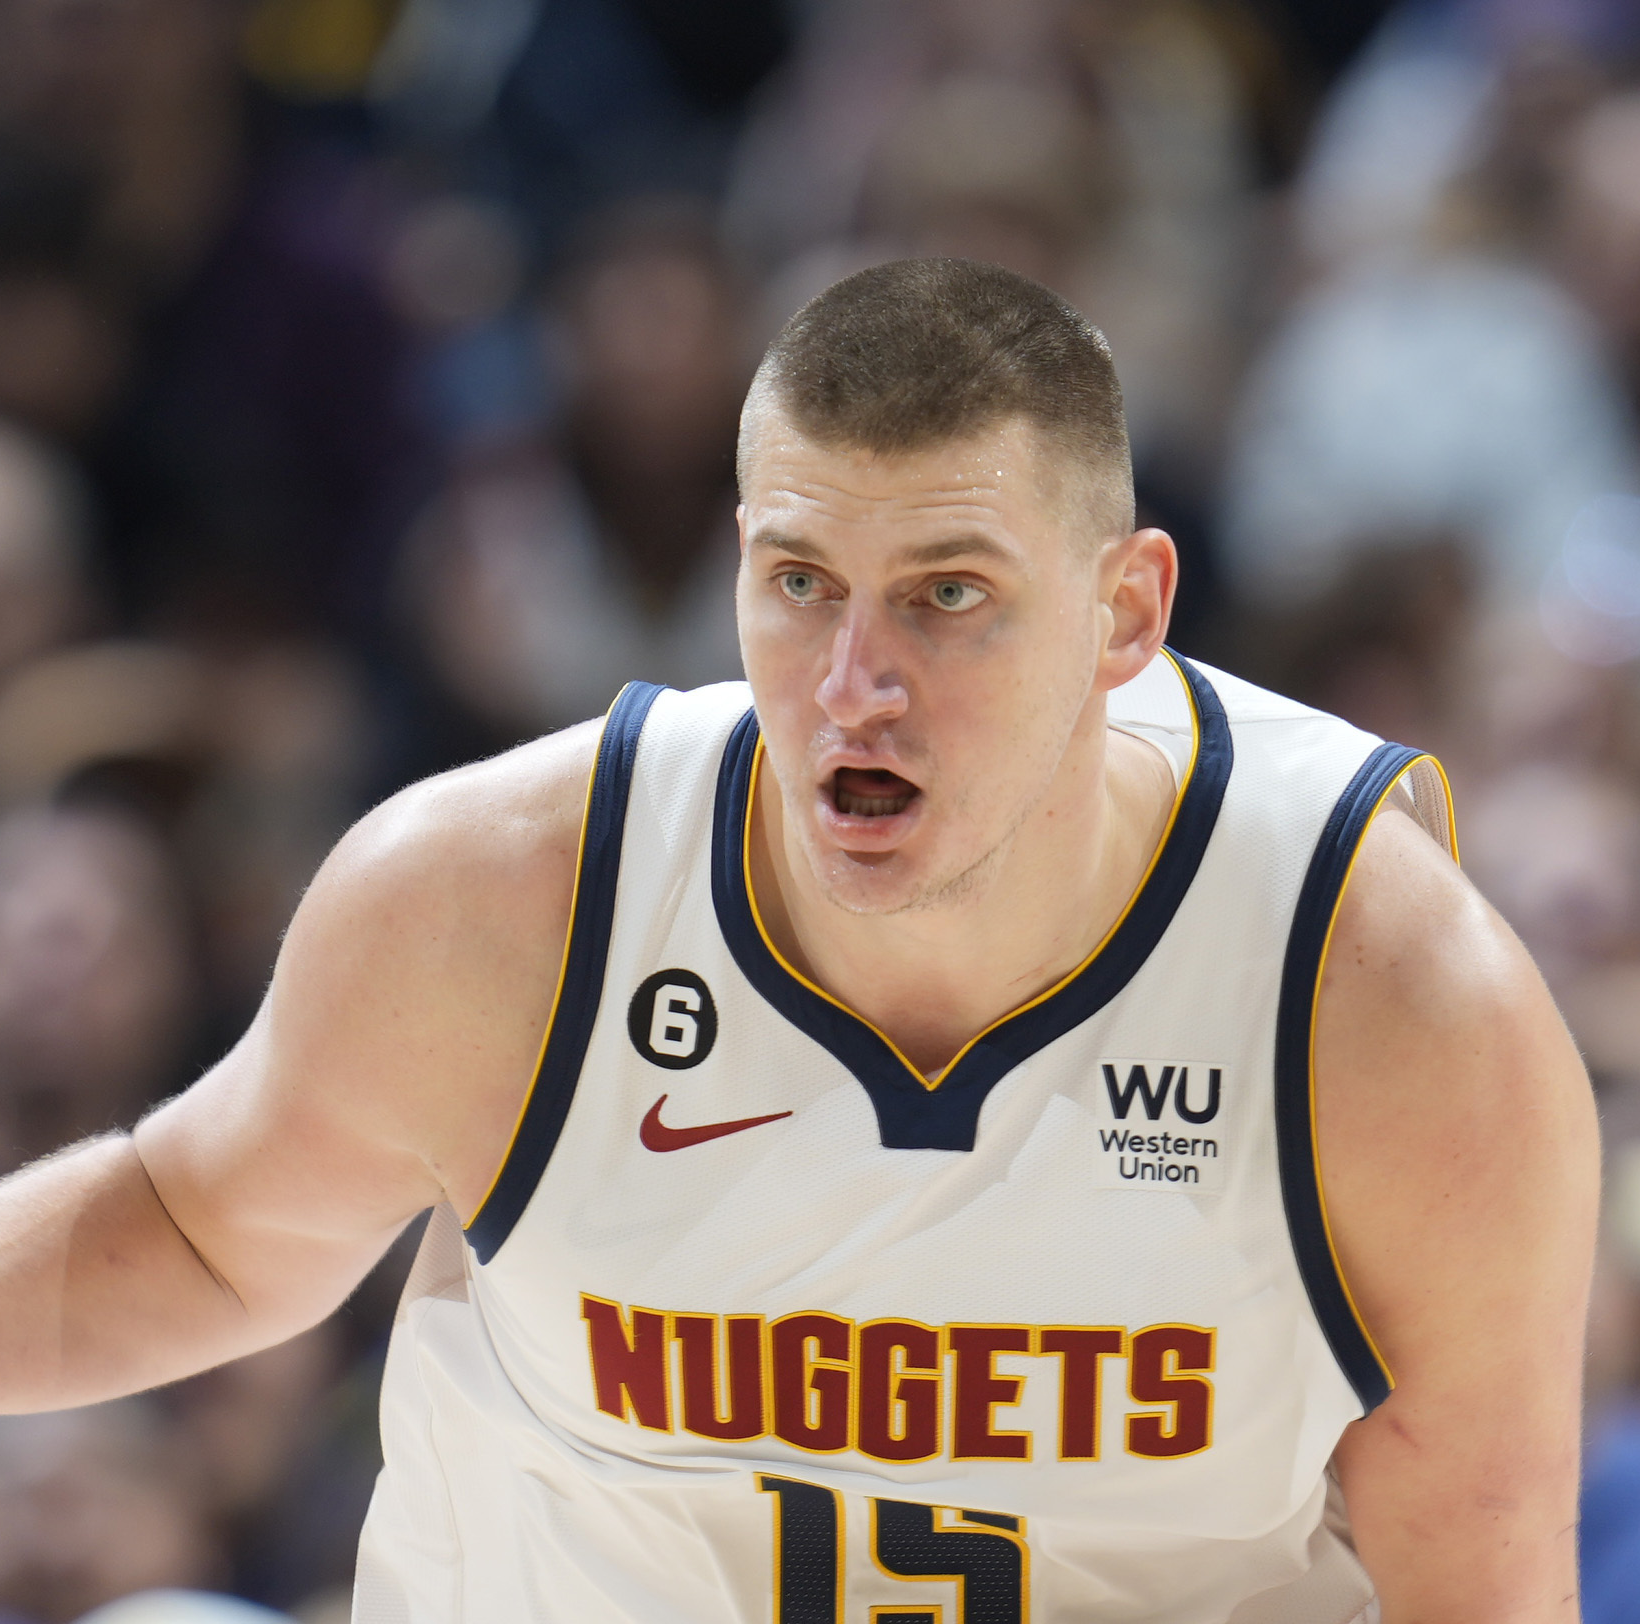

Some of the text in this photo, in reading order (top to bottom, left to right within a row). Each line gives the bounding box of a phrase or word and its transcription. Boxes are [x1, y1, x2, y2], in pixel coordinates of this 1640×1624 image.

[648, 984, 703, 1059] 6
[1101, 1064, 1222, 1124] WU
[1099, 1129, 1218, 1158] Western
[1119, 1156, 1199, 1183] Union
[579, 1290, 1217, 1464] NUGGETS
